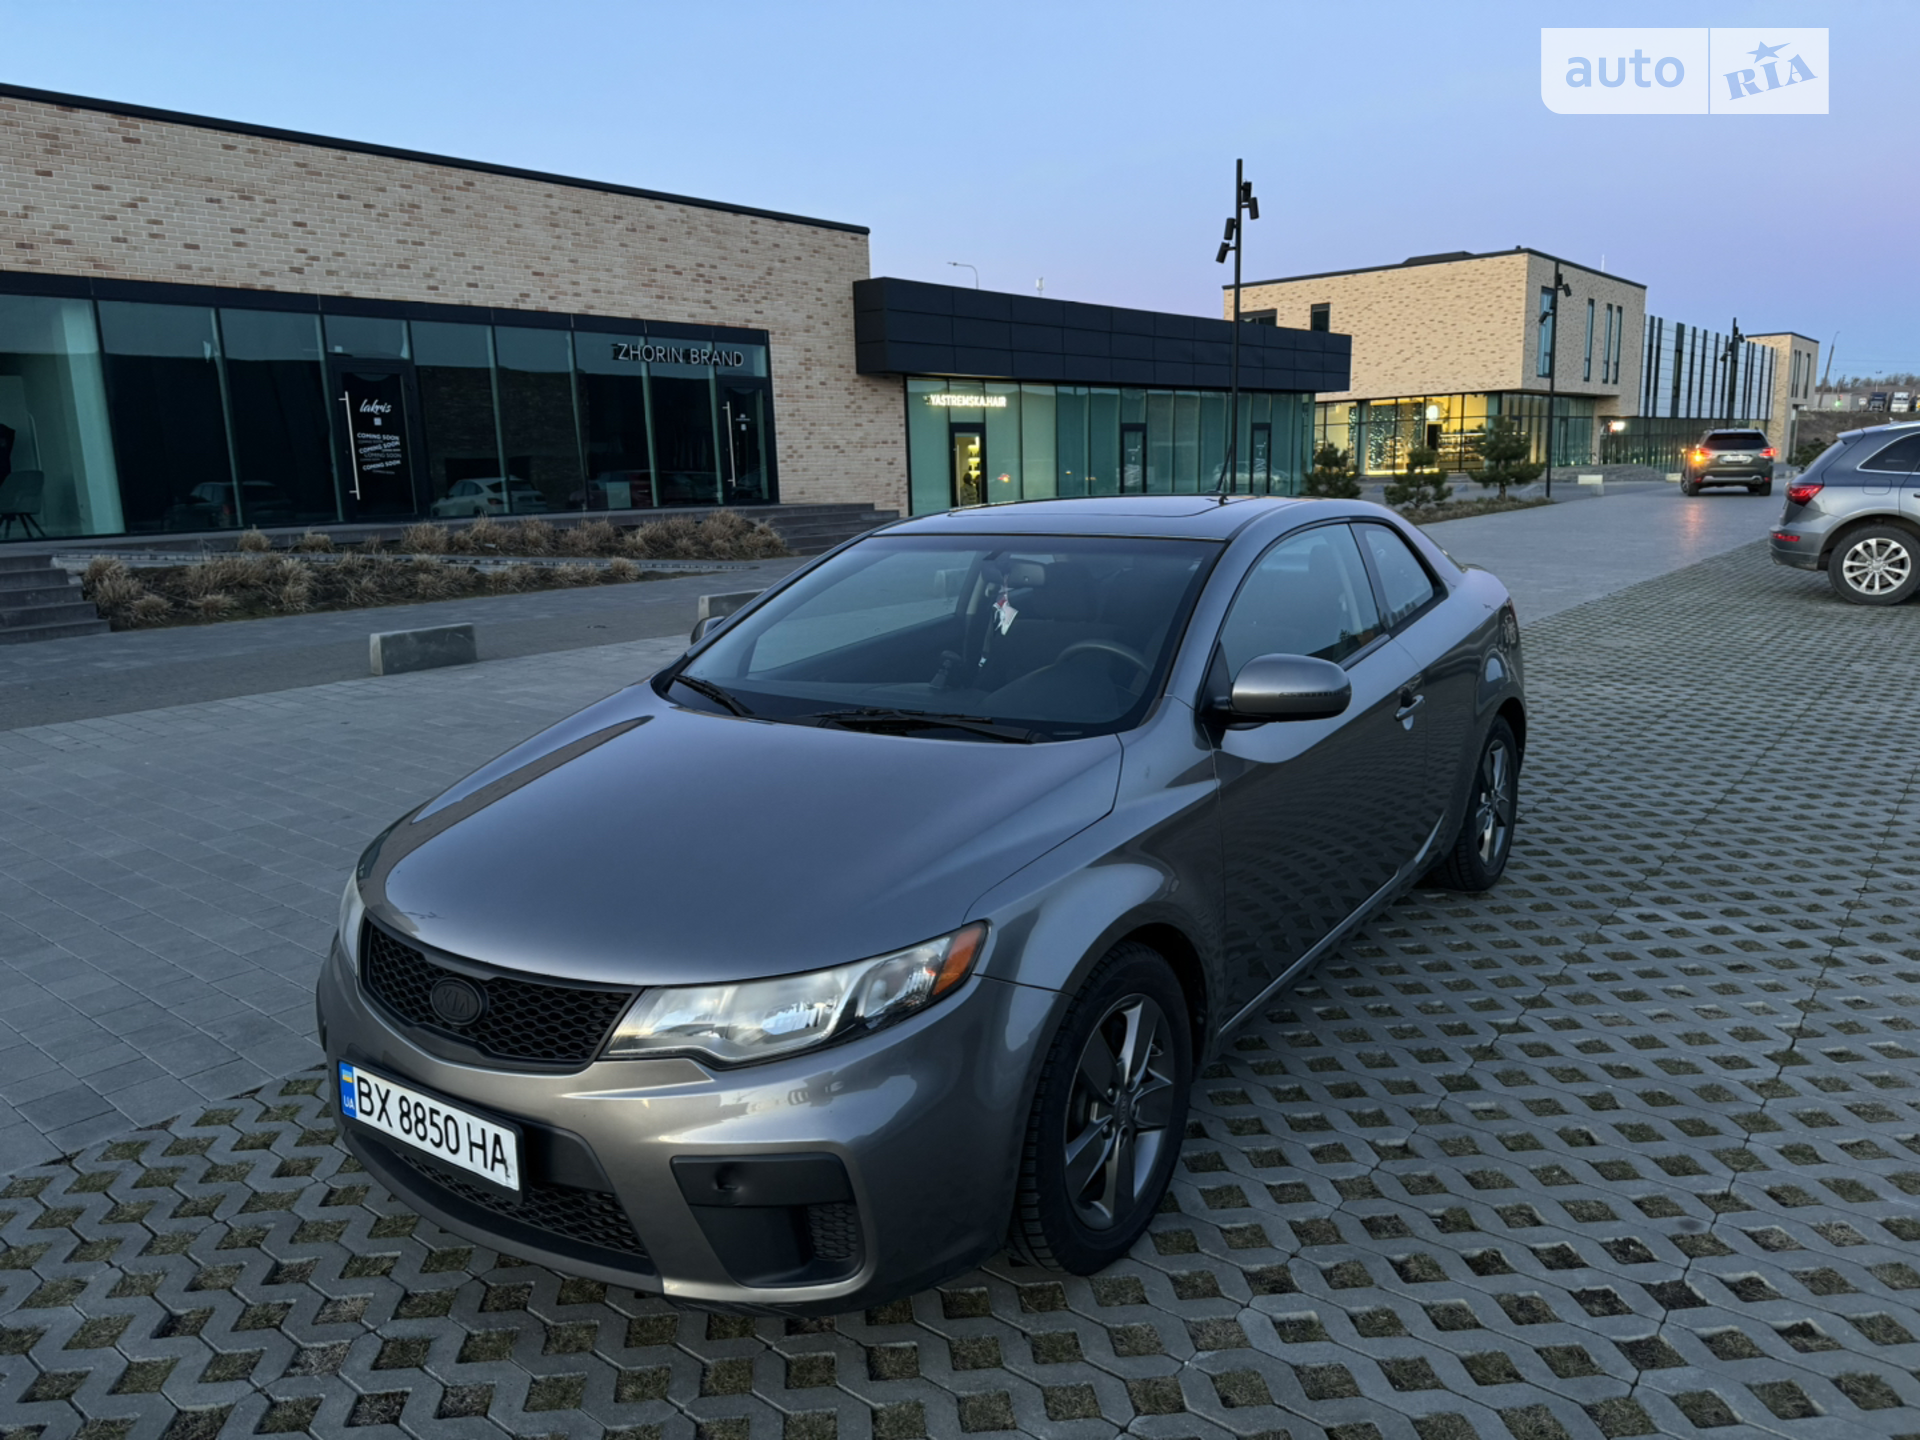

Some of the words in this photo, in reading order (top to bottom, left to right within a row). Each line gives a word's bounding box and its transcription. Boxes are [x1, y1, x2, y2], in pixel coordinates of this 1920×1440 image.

[617, 343, 684, 363] ZHORIN
[690, 347, 744, 367] BRAND
[357, 432, 381, 440] COMING
[359, 443, 382, 453] COMING
[362, 462, 384, 471] COMING
[385, 459, 401, 467] SOON
[343, 1095, 355, 1110] UA
[357, 1075, 393, 1128] BX
[399, 1095, 460, 1155] 8850
[466, 1121, 511, 1178] HA
